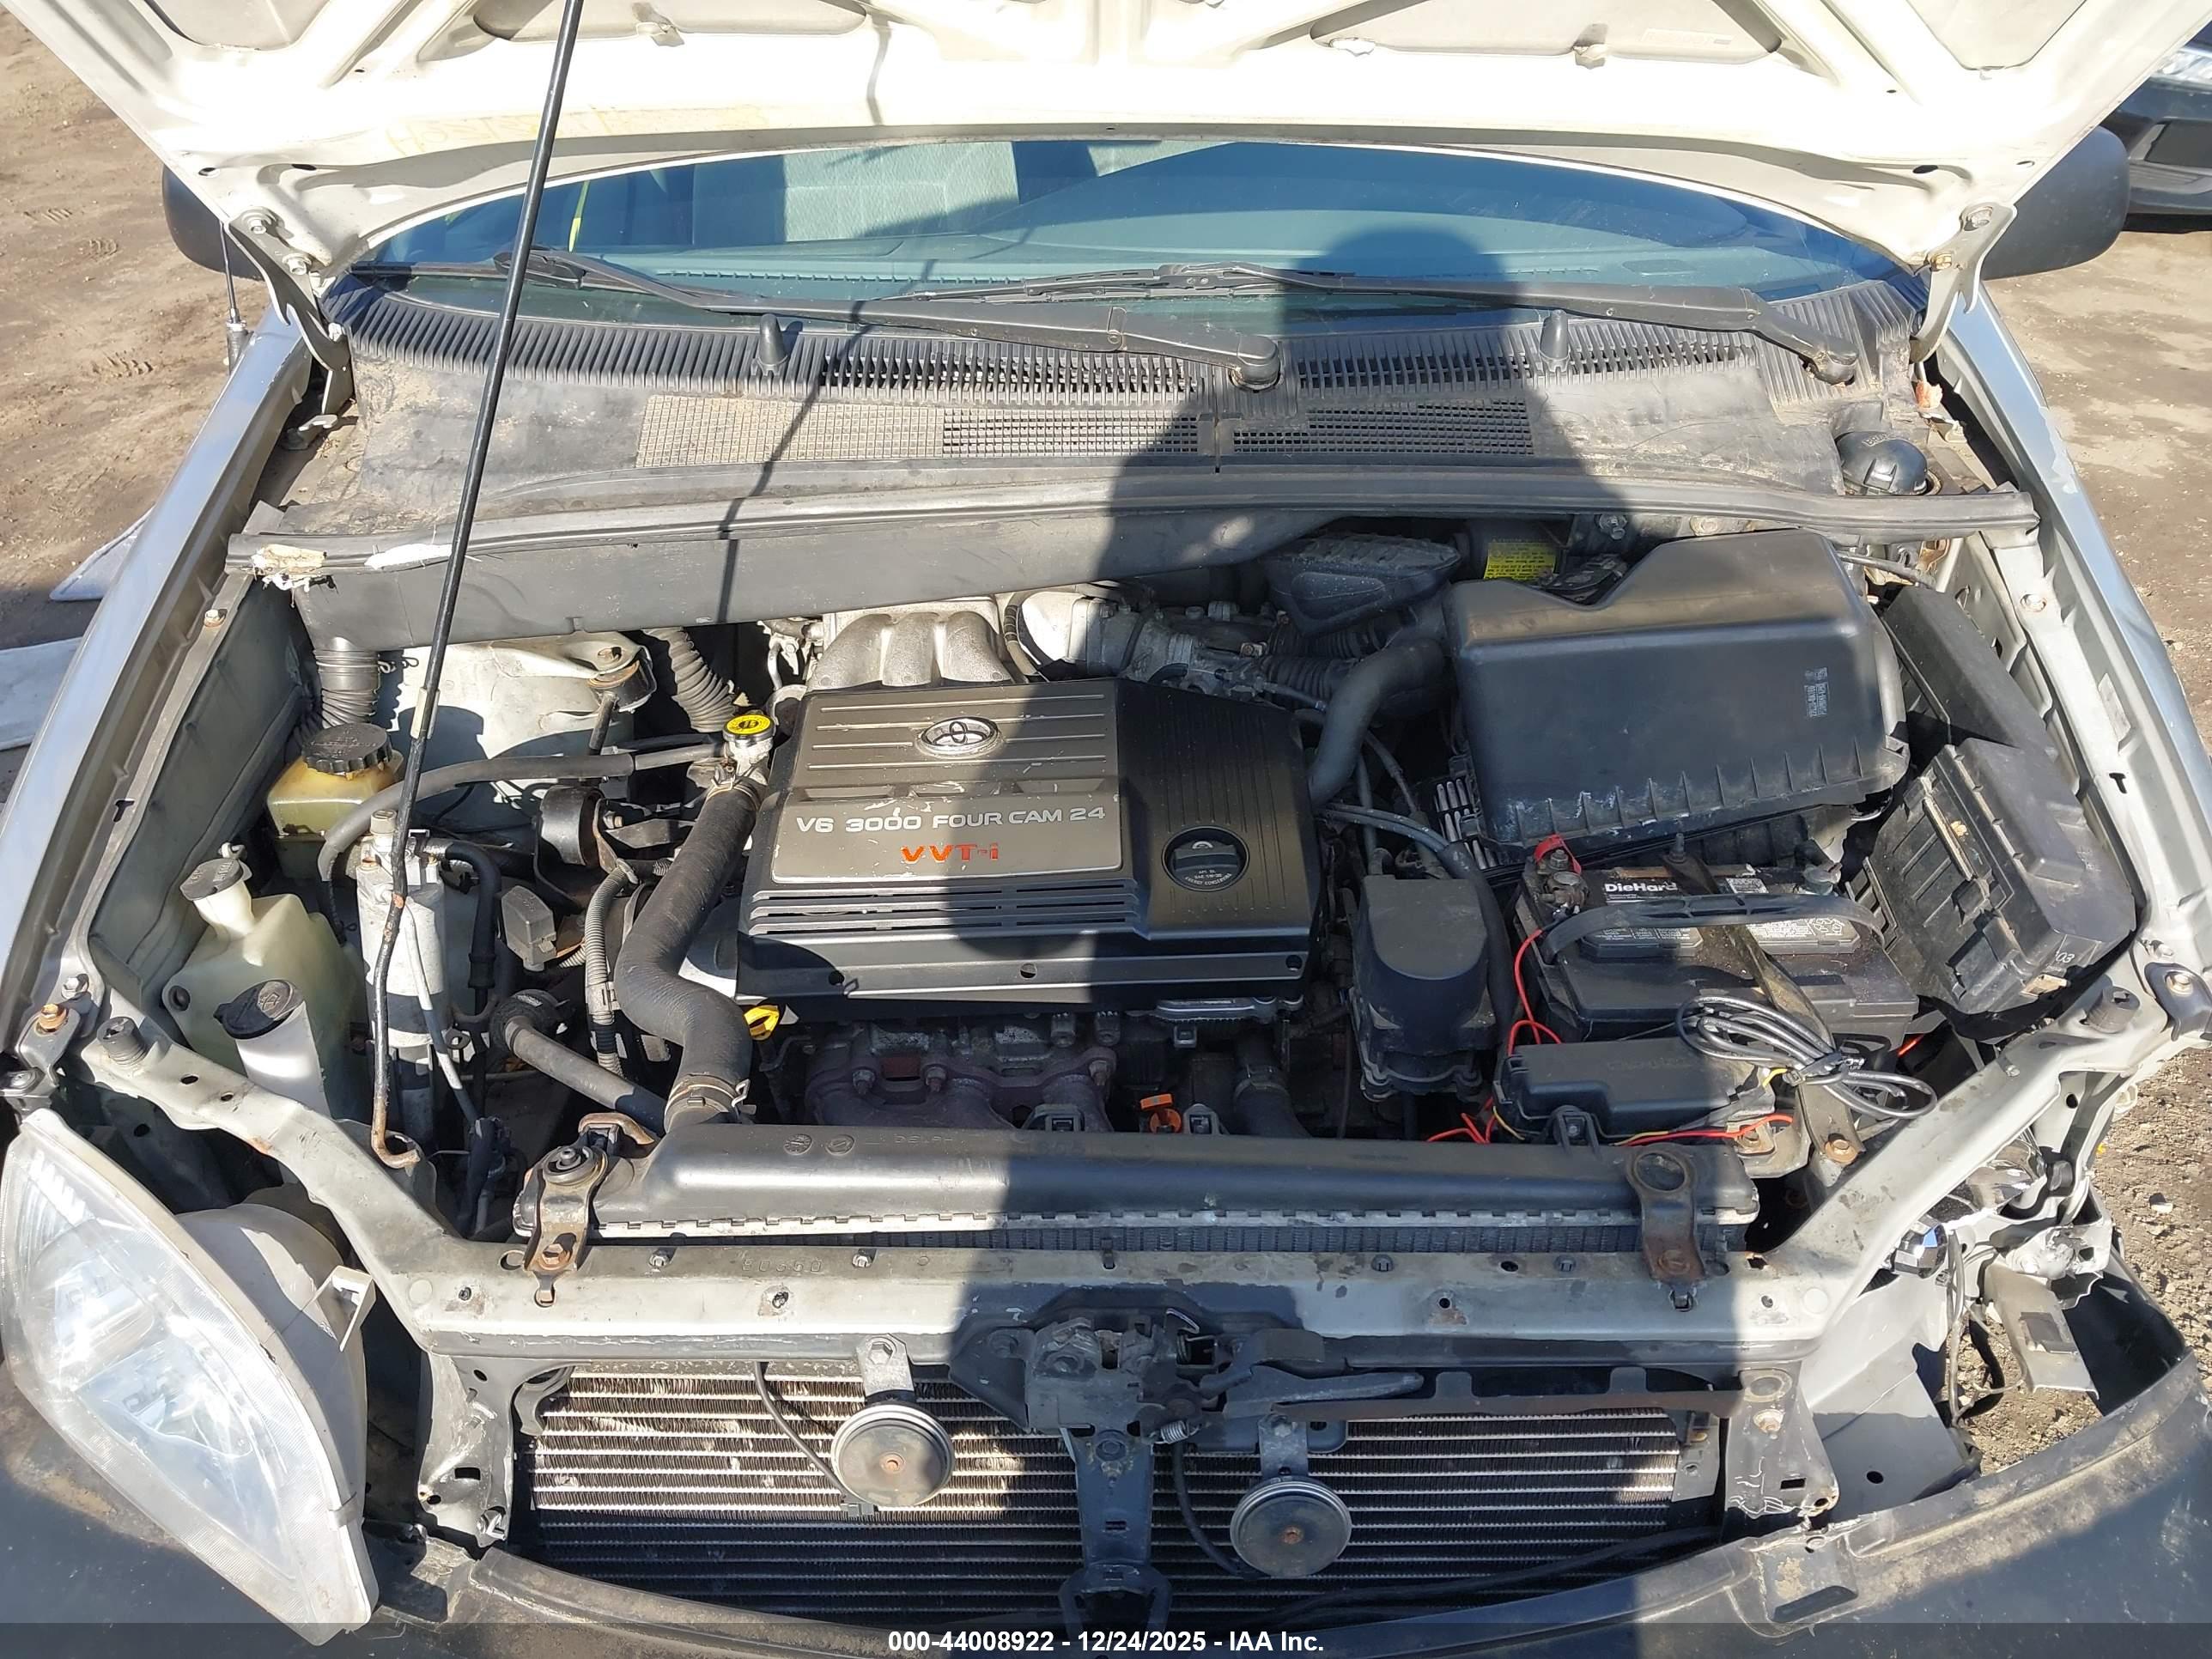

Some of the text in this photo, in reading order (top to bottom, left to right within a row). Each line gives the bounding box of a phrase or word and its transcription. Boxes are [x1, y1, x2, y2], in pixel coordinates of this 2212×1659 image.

[796, 807, 1106, 833] V6 3000 FOUR CAM 24
[901, 843, 1000, 864] VVT-i
[1605, 881, 1679, 892] DieHard
